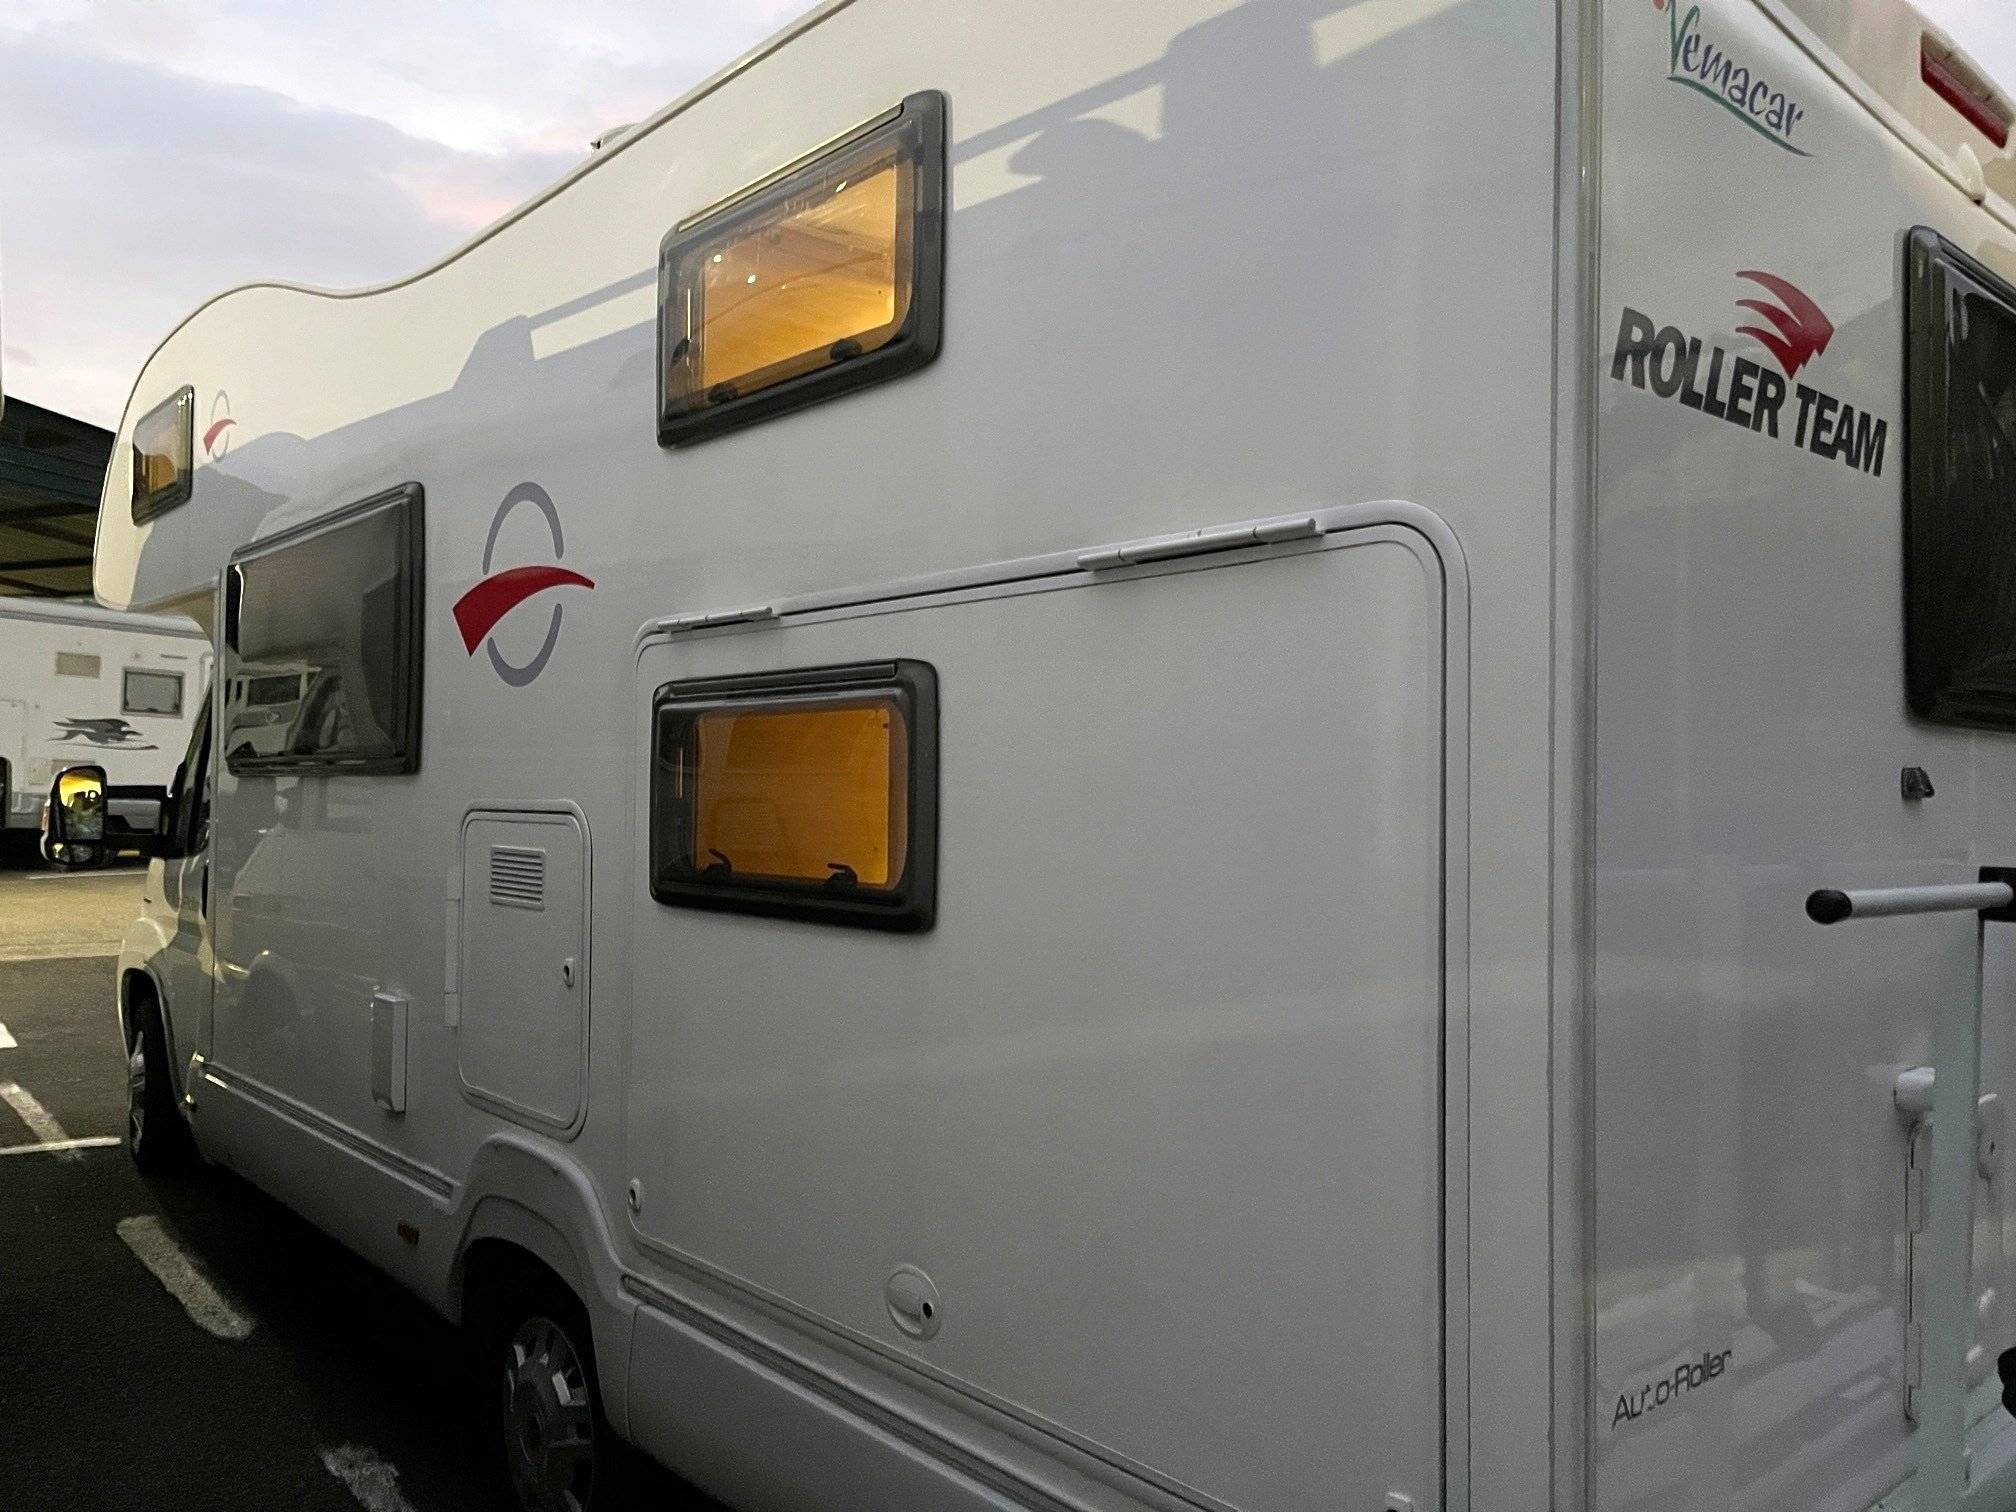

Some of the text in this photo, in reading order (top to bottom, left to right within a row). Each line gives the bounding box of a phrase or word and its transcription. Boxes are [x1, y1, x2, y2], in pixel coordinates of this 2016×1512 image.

[1664, 0, 1804, 138] Vemacar
[1610, 306, 1888, 478] ROLLER TEAM
